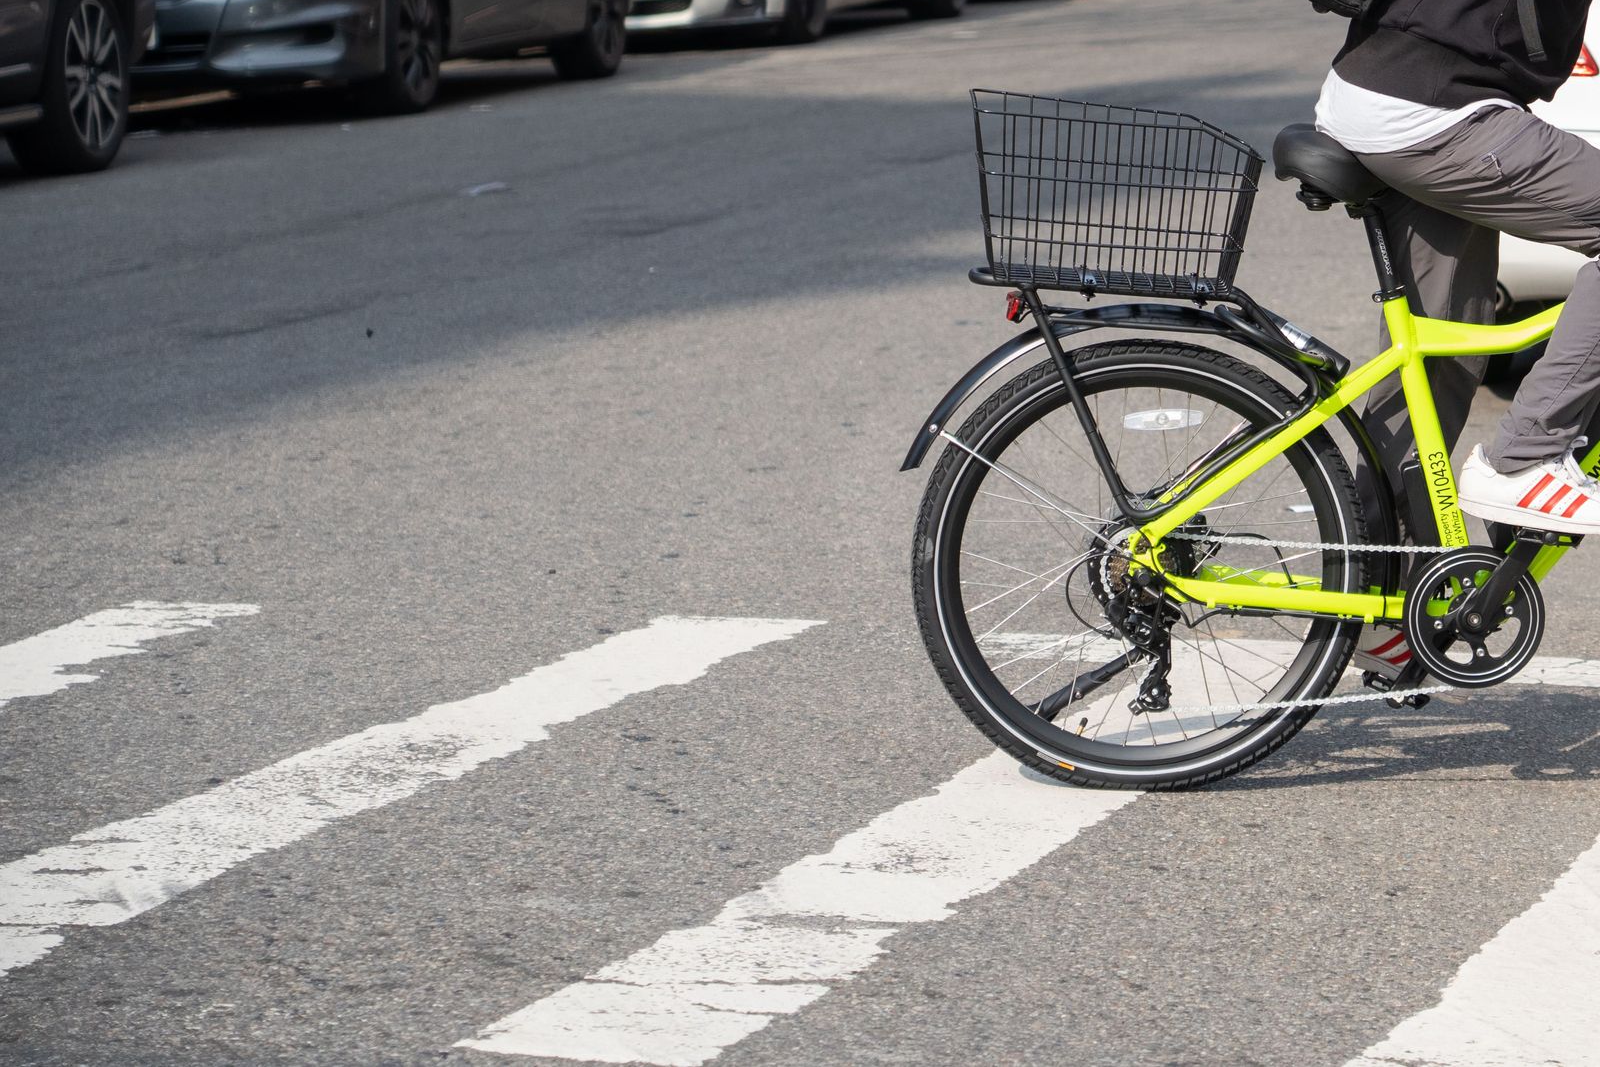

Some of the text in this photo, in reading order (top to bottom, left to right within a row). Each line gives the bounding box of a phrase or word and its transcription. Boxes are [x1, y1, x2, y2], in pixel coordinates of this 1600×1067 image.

[1428, 451, 1454, 511] W10433
[1440, 513, 1453, 547] Property
[1452, 510, 1461, 533] Whizz
